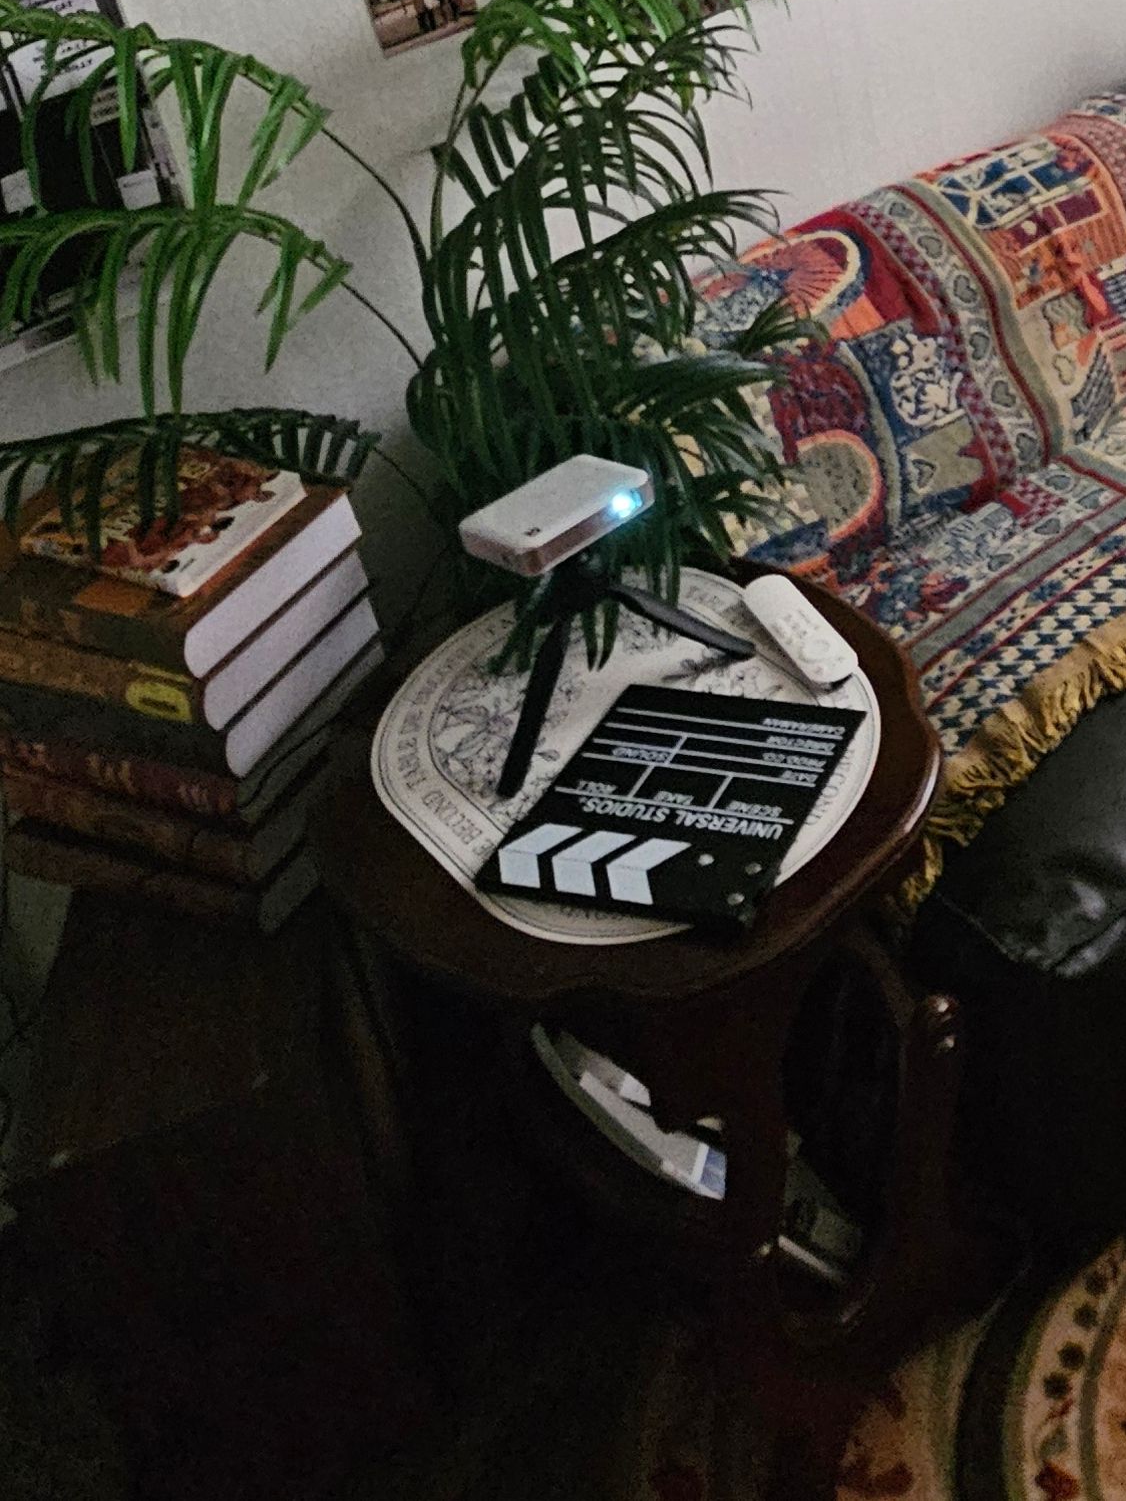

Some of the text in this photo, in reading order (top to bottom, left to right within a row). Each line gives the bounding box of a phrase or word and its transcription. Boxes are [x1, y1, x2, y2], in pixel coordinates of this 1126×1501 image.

[762, 717, 846, 735] CAMERAMAN
[766, 735, 836, 750] DIRECTOR
[611, 747, 671, 761] SOUND
[780, 769, 819, 783] DATE
[577, 780, 617, 795] ROLL
[653, 790, 694, 806] TAKE
[726, 799, 783, 818] SCENE
[582, 797, 784, 840] UNIVERSAL STUDIOS
